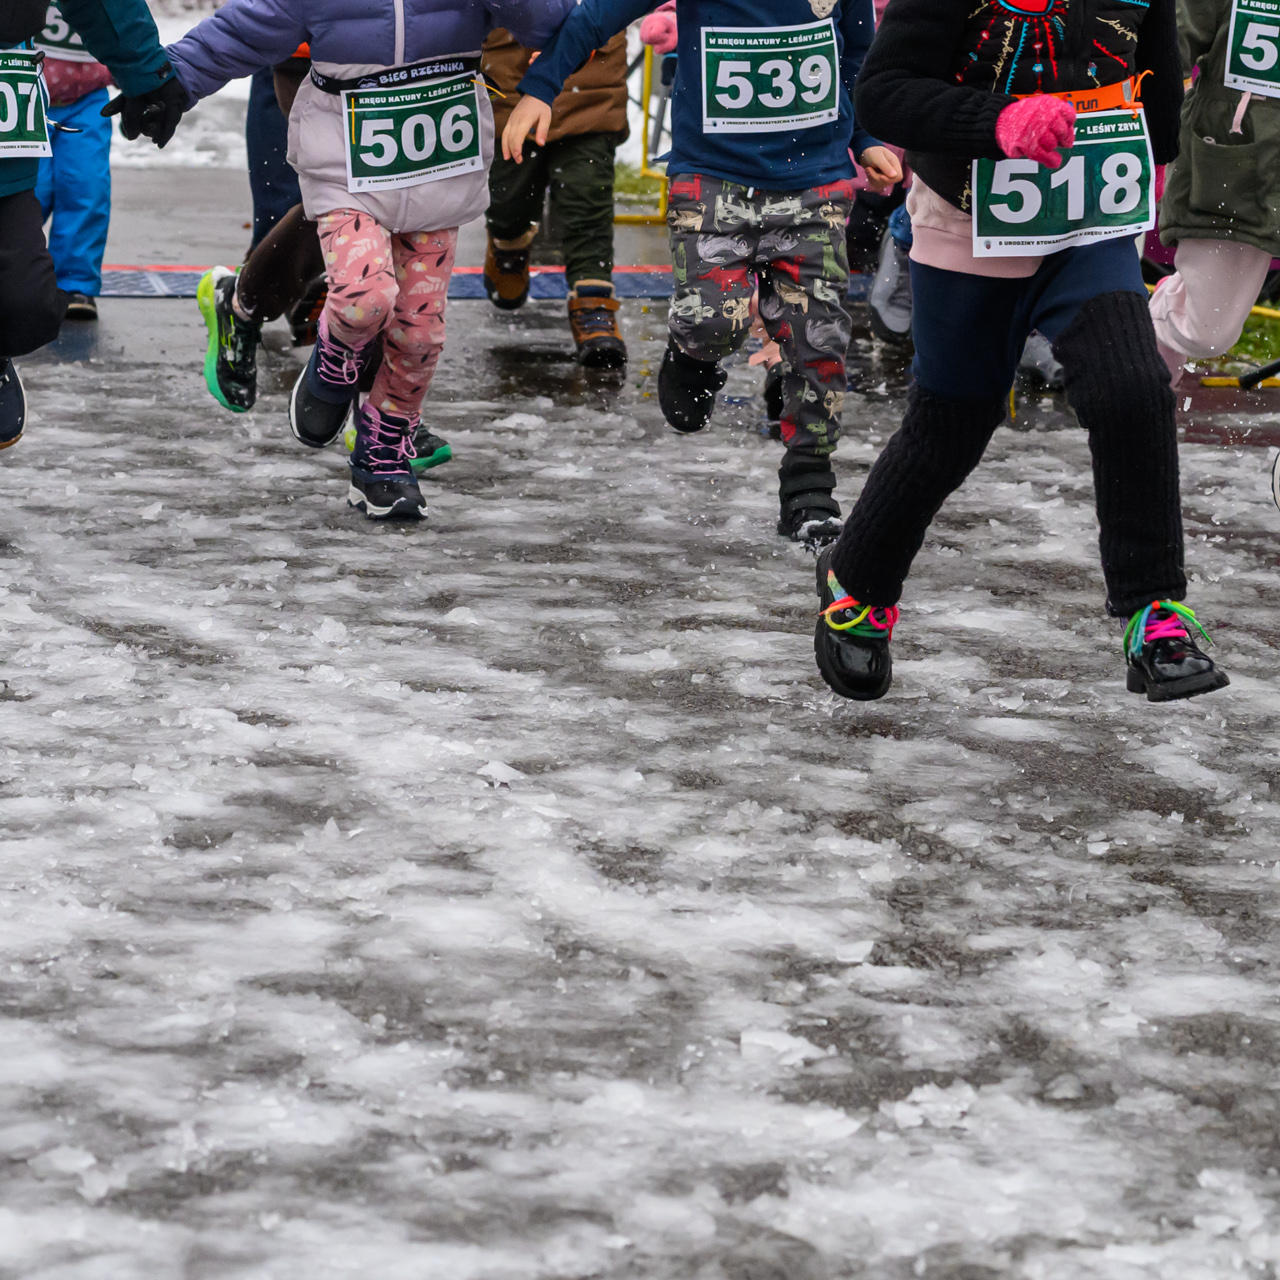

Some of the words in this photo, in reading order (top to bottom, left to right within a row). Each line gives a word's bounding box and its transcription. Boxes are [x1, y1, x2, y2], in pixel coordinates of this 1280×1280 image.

[1249, 1, 1278, 11] KRĘGU
[718, 38, 745, 47] KRĘGU
[746, 38, 781, 46] NATURY
[788, 33, 813, 44] LEŚNY
[813, 31, 831, 40] ZRYW
[715, 55, 832, 109] 539
[359, 96, 387, 106] KRĘGU
[388, 93, 422, 103] NATURY
[428, 86, 452, 98] LEŚNY
[1076, 98, 1098, 110] run
[359, 104, 474, 167] 506
[1087, 122, 1116, 135] LEŚNY
[1117, 121, 1140, 132] ZRYW
[989, 152, 1142, 223] 518
